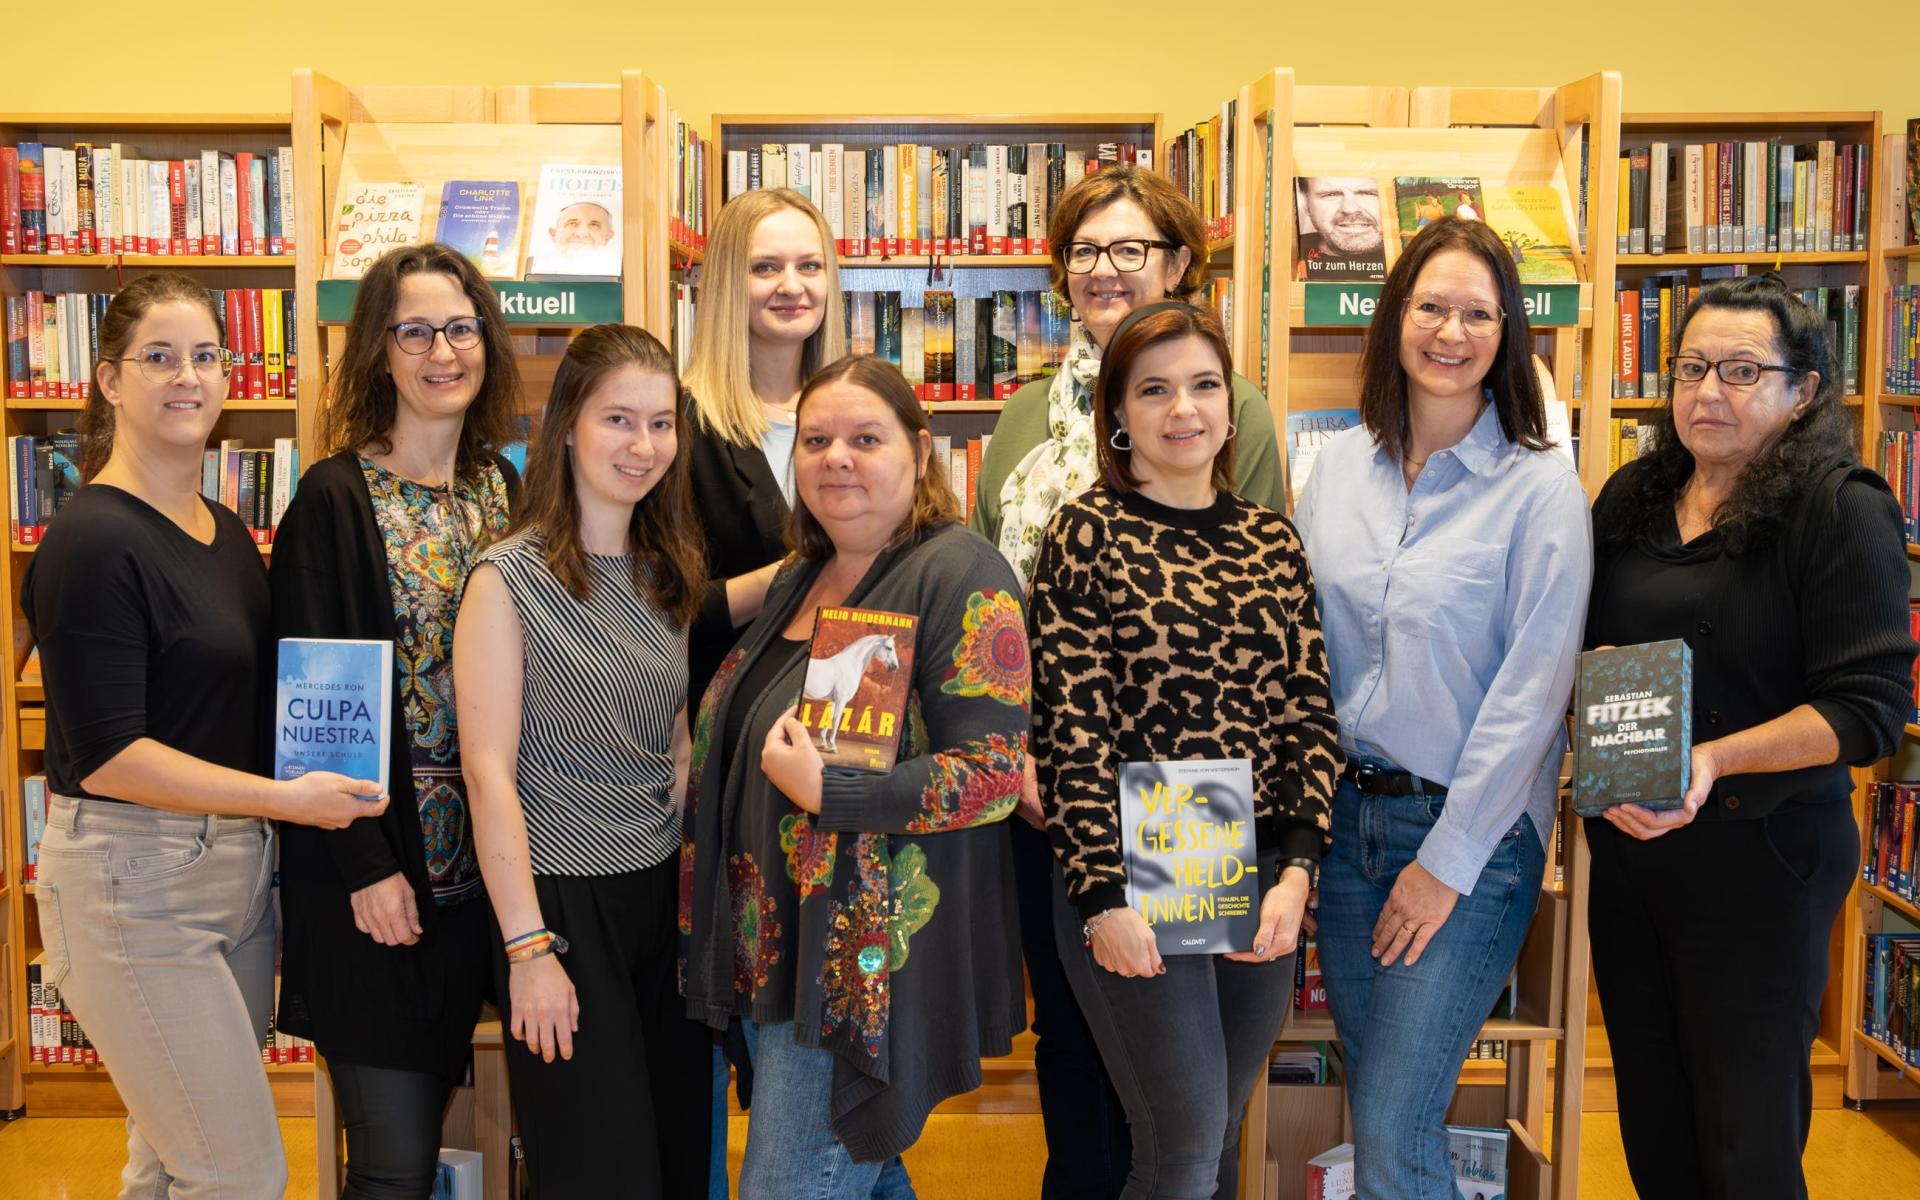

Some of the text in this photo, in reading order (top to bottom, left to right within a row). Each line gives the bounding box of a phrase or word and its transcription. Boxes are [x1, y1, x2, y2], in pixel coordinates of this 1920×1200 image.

[79, 157, 88, 203] CARI MORA
[356, 188, 386, 205] die
[1308, 261, 1384, 271] Tor zum Herzen
[499, 292, 575, 315] ktuell
[1339, 292, 1380, 316] Ne
[1622, 313, 1632, 375] NIKI LAUDA
[1301, 417, 1349, 431] HERA
[851, 612, 913, 629] BIEDERMANN
[296, 683, 341, 691] MERCEDES
[1604, 690, 1652, 703] SEBASTIAN
[288, 698, 371, 722] CULPA
[802, 701, 896, 737] LÁZÁR
[1586, 695, 1673, 726] FITZEK
[283, 725, 376, 745] NUESTRA
[1590, 727, 1666, 747] NACHBAR
[1617, 722, 1638, 732] DER
[1623, 746, 1668, 756] PSYCHOTHRILLER
[1140, 781, 1208, 816] VER-
[1137, 820, 1246, 859] GESSENE
[1173, 854, 1258, 889] HELD-
[1140, 893, 1215, 928] INNEN
[32, 983, 42, 1006] FROST
